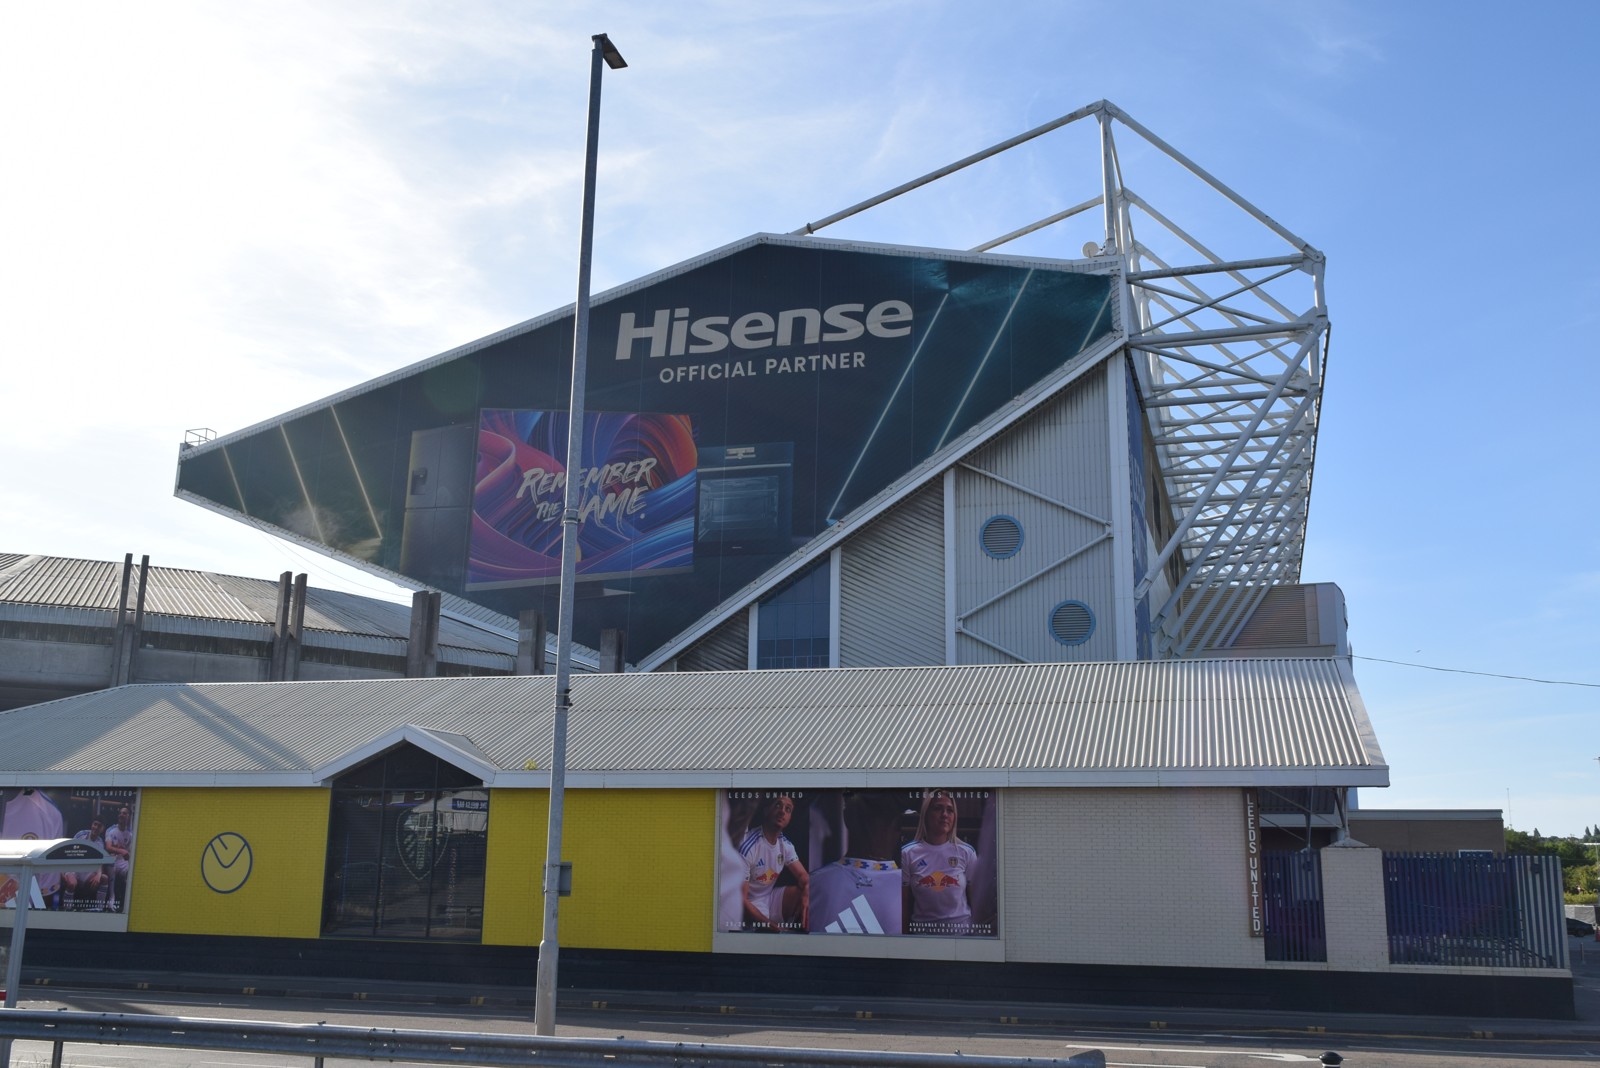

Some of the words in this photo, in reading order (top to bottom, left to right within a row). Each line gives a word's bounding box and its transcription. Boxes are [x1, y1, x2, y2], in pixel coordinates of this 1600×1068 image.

[615, 300, 913, 360] Hisense
[659, 361, 757, 383] OFFICIAL
[765, 352, 866, 374] PARTNER
[536, 501, 561, 523] THE
[728, 791, 760, 799] LEEDS
[765, 791, 804, 799] UNITED
[909, 791, 942, 799] LEEDS
[949, 791, 990, 799] UNITED
[1246, 793, 1257, 854] LEEDS
[1249, 857, 1261, 931] UNITED
